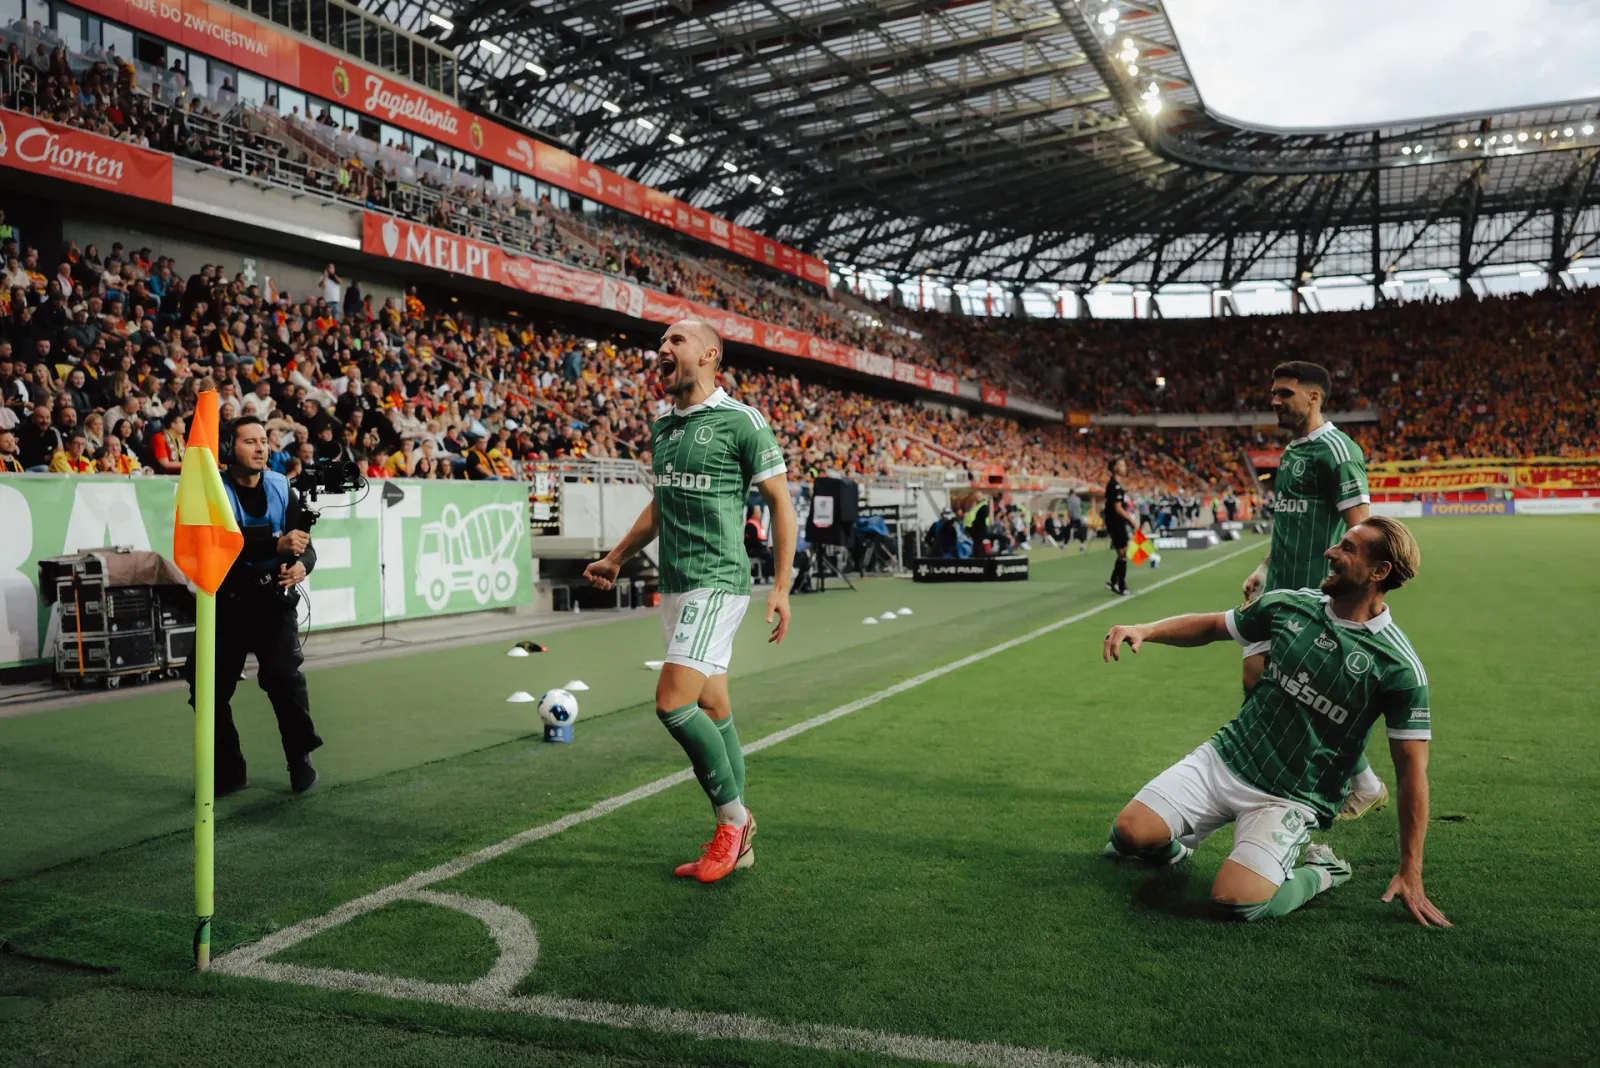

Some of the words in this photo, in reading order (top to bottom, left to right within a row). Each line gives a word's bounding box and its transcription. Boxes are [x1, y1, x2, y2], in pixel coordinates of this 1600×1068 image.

[160, 4, 181, 23] DO
[184, 13, 268, 57] ZWYCIĘSTWA!
[365, 75, 458, 135] Jagiellonia
[15, 127, 124, 179] Chorten
[405, 223, 491, 280] MELPI
[957, 566, 984, 575] PARK
